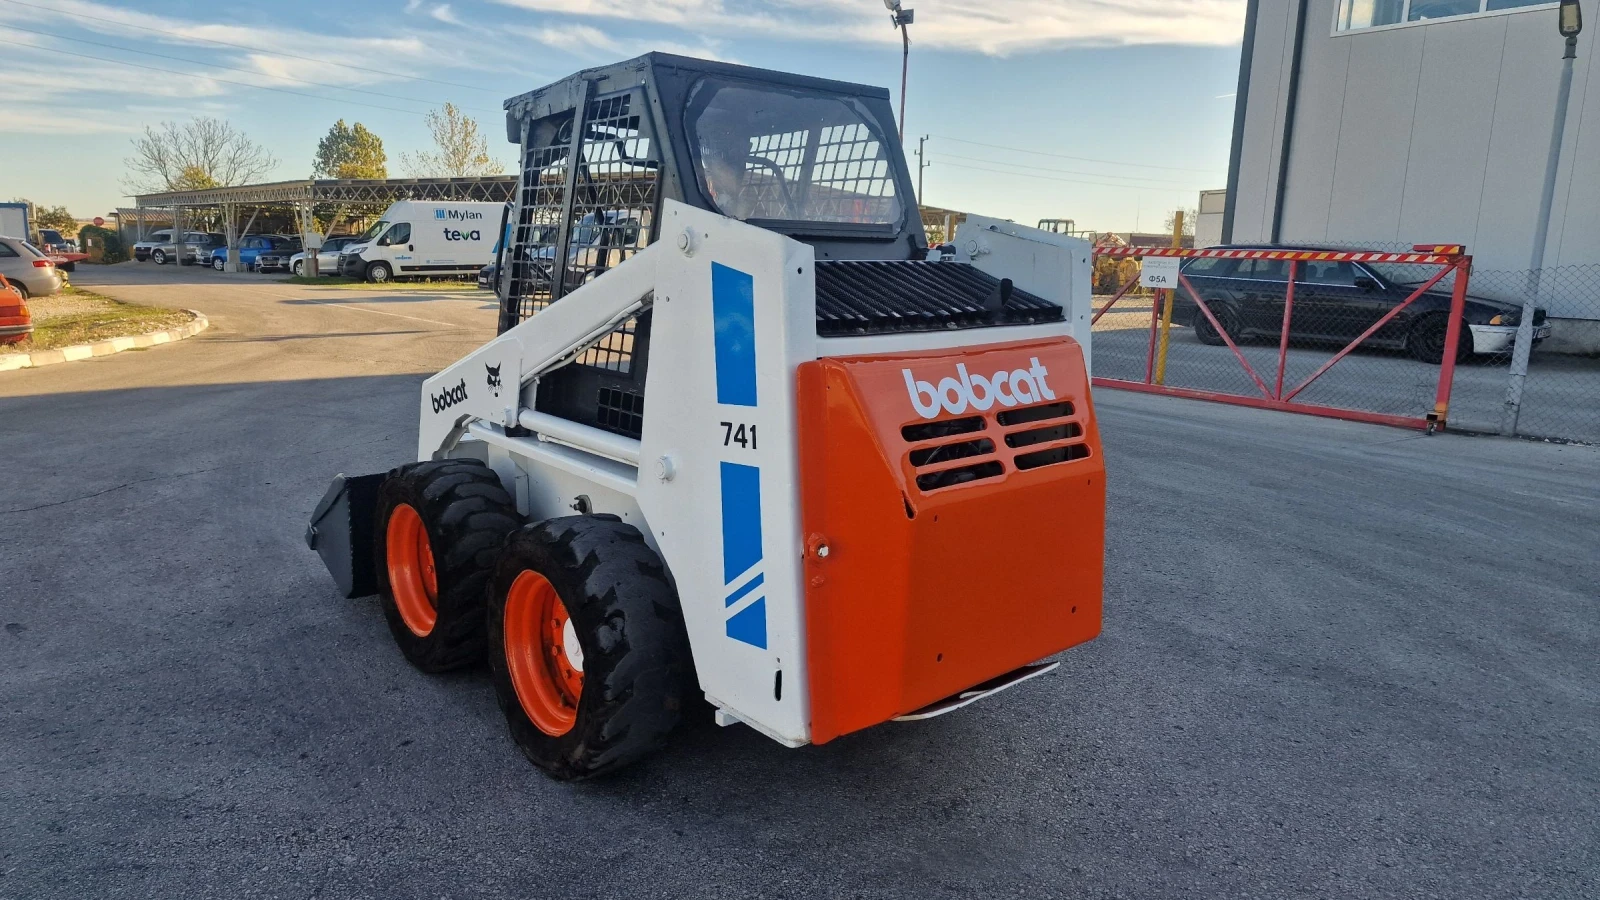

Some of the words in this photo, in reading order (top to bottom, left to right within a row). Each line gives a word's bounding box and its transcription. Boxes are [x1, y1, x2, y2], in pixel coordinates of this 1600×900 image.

[448, 210, 482, 221] Mylan
[443, 227, 481, 241] teva
[431, 377, 468, 414] bobcat
[902, 356, 1056, 419] bobcat
[720, 421, 757, 450] 741
